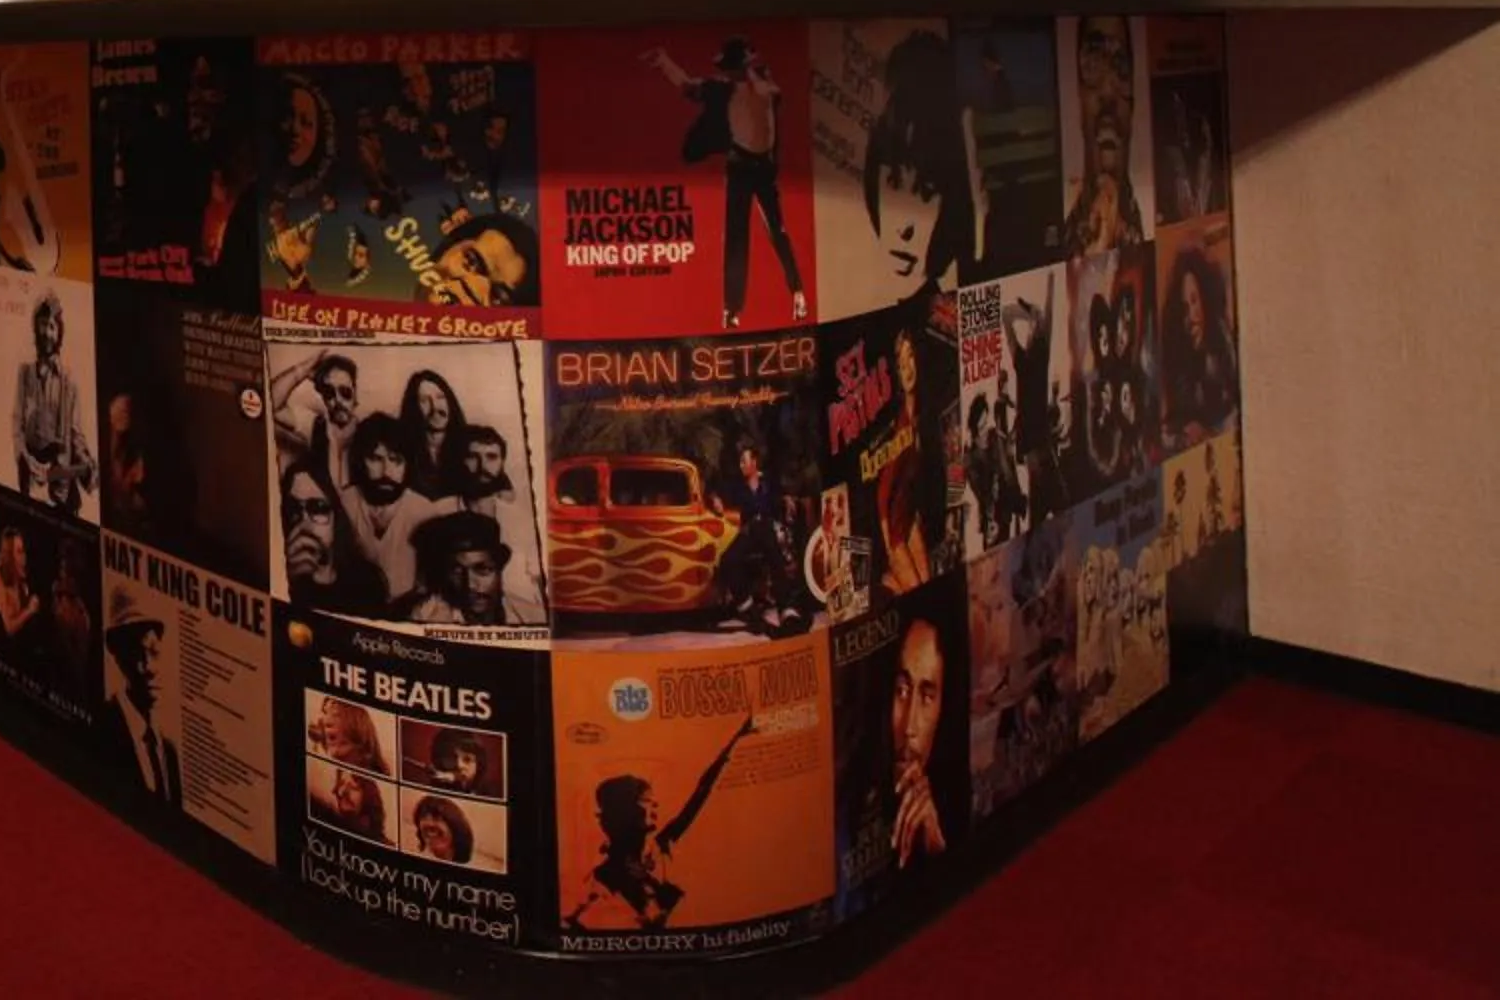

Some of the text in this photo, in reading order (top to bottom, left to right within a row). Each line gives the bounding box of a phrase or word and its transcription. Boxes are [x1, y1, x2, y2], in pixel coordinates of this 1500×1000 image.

[565, 185, 692, 215] MICHAEL
[563, 214, 695, 245] JACKSON
[567, 241, 696, 266] KING OF POP
[272, 299, 528, 339] LIFE ON PLANET GROOVE
[557, 337, 815, 386] BRIAN SETZER
[105, 535, 266, 637] NAT KING COLE
[352, 632, 444, 665] Apple Records
[834, 609, 900, 660] LEGEND
[320, 656, 492, 720] THE BEATLES
[659, 668, 751, 720] BOSSA
[759, 654, 818, 708] NOVA
[303, 826, 516, 912] You know my name
[354, 888, 381, 910] up
[386, 893, 421, 921] the
[426, 907, 519, 945] number)
[560, 934, 699, 952] MERCURY
